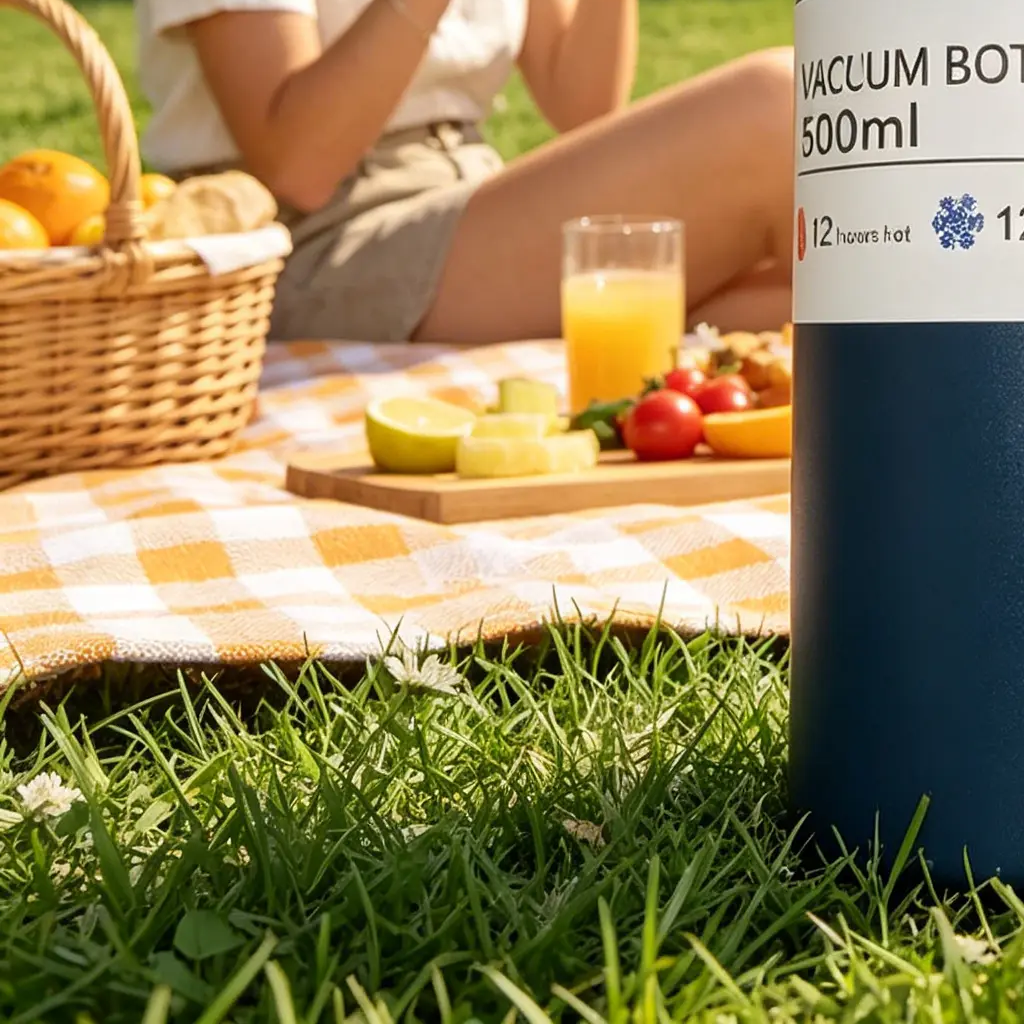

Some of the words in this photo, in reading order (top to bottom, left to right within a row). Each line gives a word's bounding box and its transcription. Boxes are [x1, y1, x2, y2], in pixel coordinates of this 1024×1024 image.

[801, 46, 928, 100] VACUUM
[801, 102, 918, 158] 500ml
[813, 215, 833, 249] 12
[883, 224, 911, 243] hot
